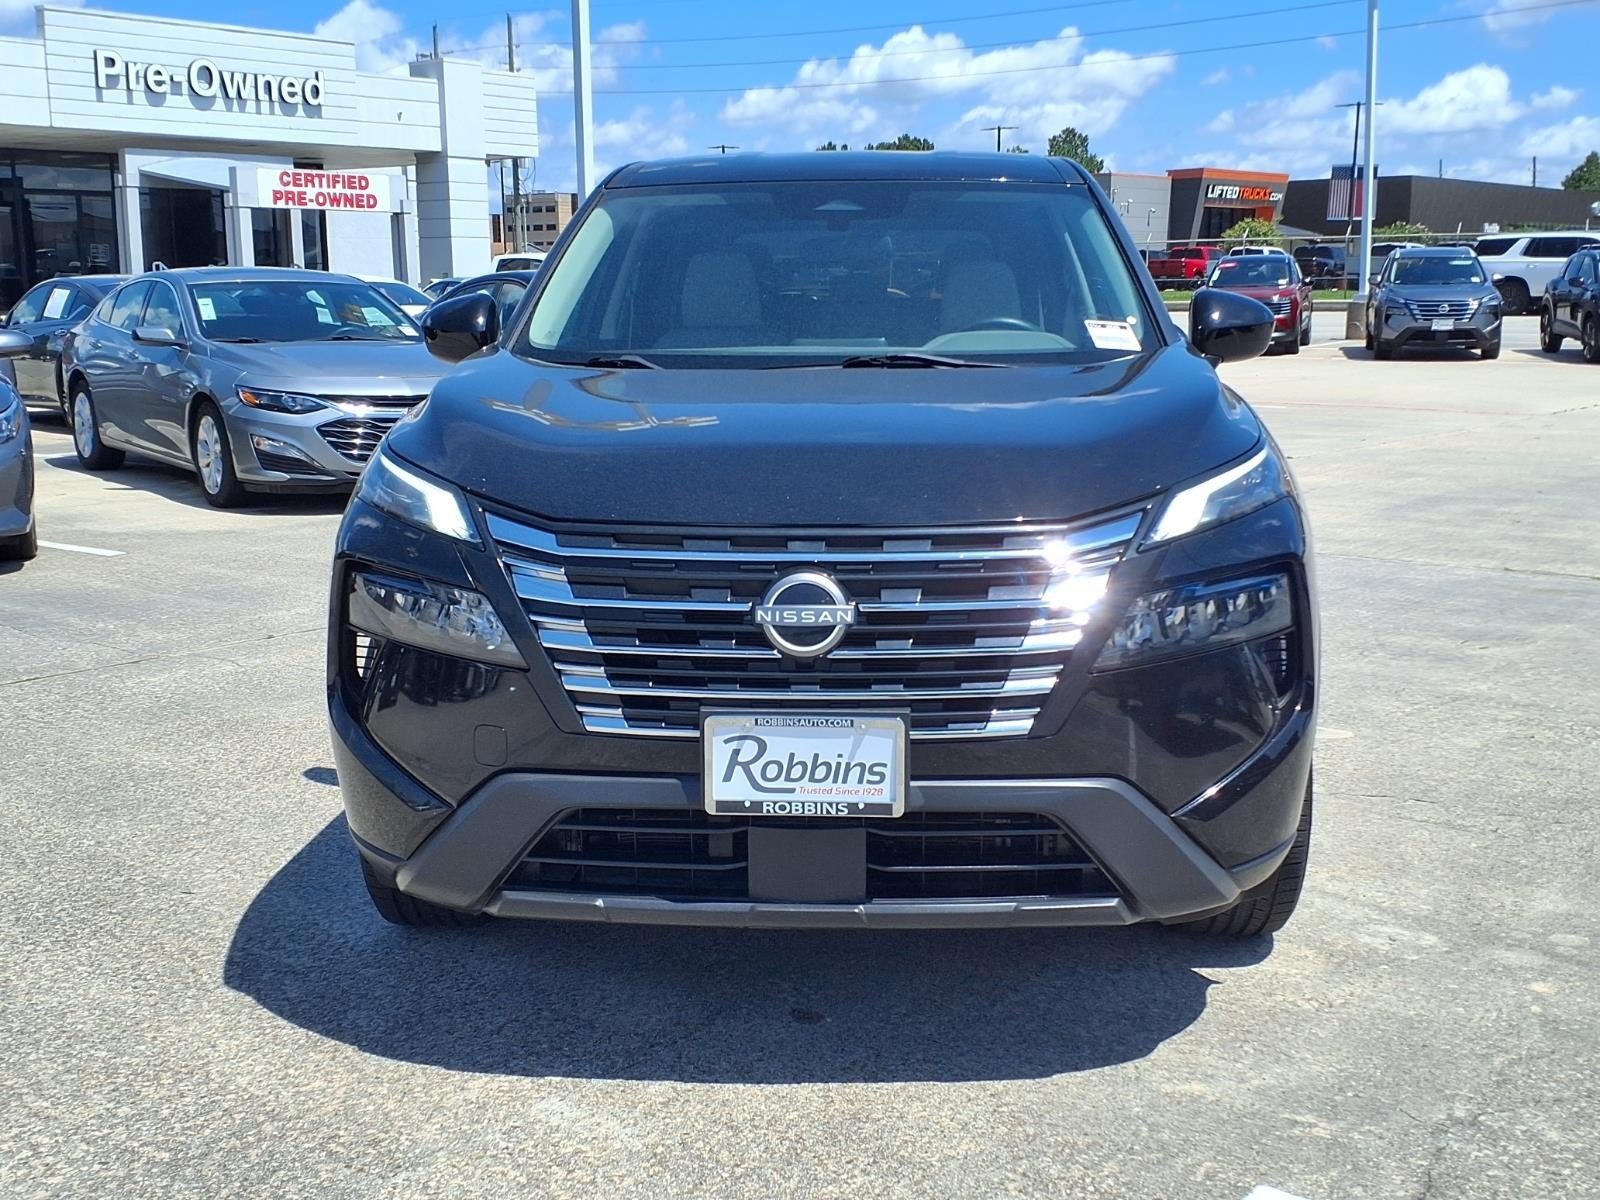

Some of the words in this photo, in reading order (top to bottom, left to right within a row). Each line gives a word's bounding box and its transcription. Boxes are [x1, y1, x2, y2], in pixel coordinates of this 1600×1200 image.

[94, 49, 324, 106] Pre-Owned
[278, 171, 370, 190] CERTIFIED
[272, 189, 378, 209] PRE-OWNED
[757, 609, 853, 623] NISSAN
[757, 718, 851, 728] ROBBINSAUTO.COM
[721, 734, 888, 794] Robbins
[799, 786, 833, 796] Trusted
[835, 786, 861, 796] Since
[862, 787, 884, 797] 1928
[762, 801, 849, 816] ROBBINS
